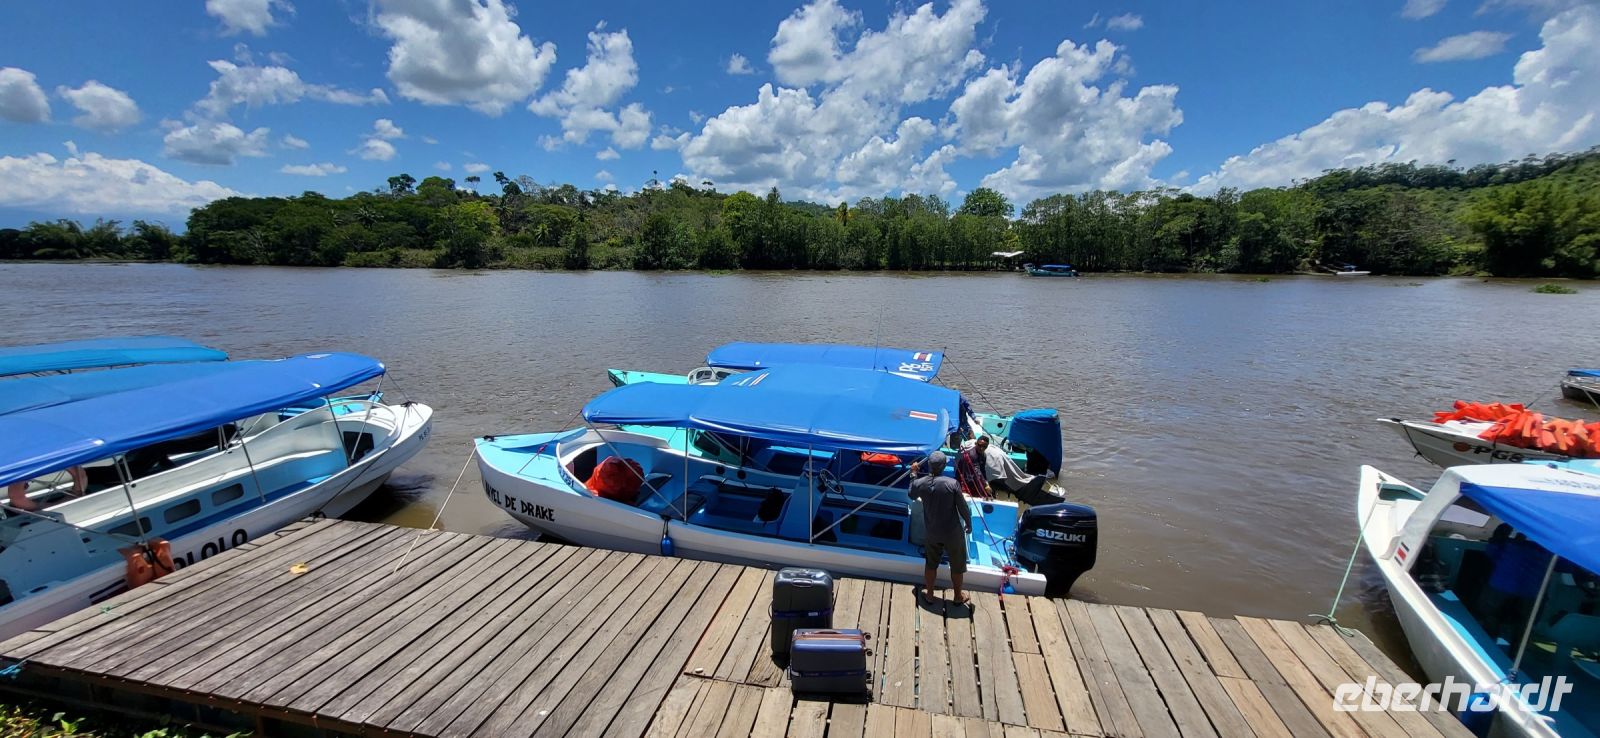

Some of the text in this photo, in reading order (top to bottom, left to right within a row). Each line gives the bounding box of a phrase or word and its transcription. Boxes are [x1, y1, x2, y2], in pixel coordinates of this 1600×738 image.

[504, 494, 517, 511] DE
[520, 499, 556, 522] DRAKE
[1035, 528, 1087, 543] SUZUKI
